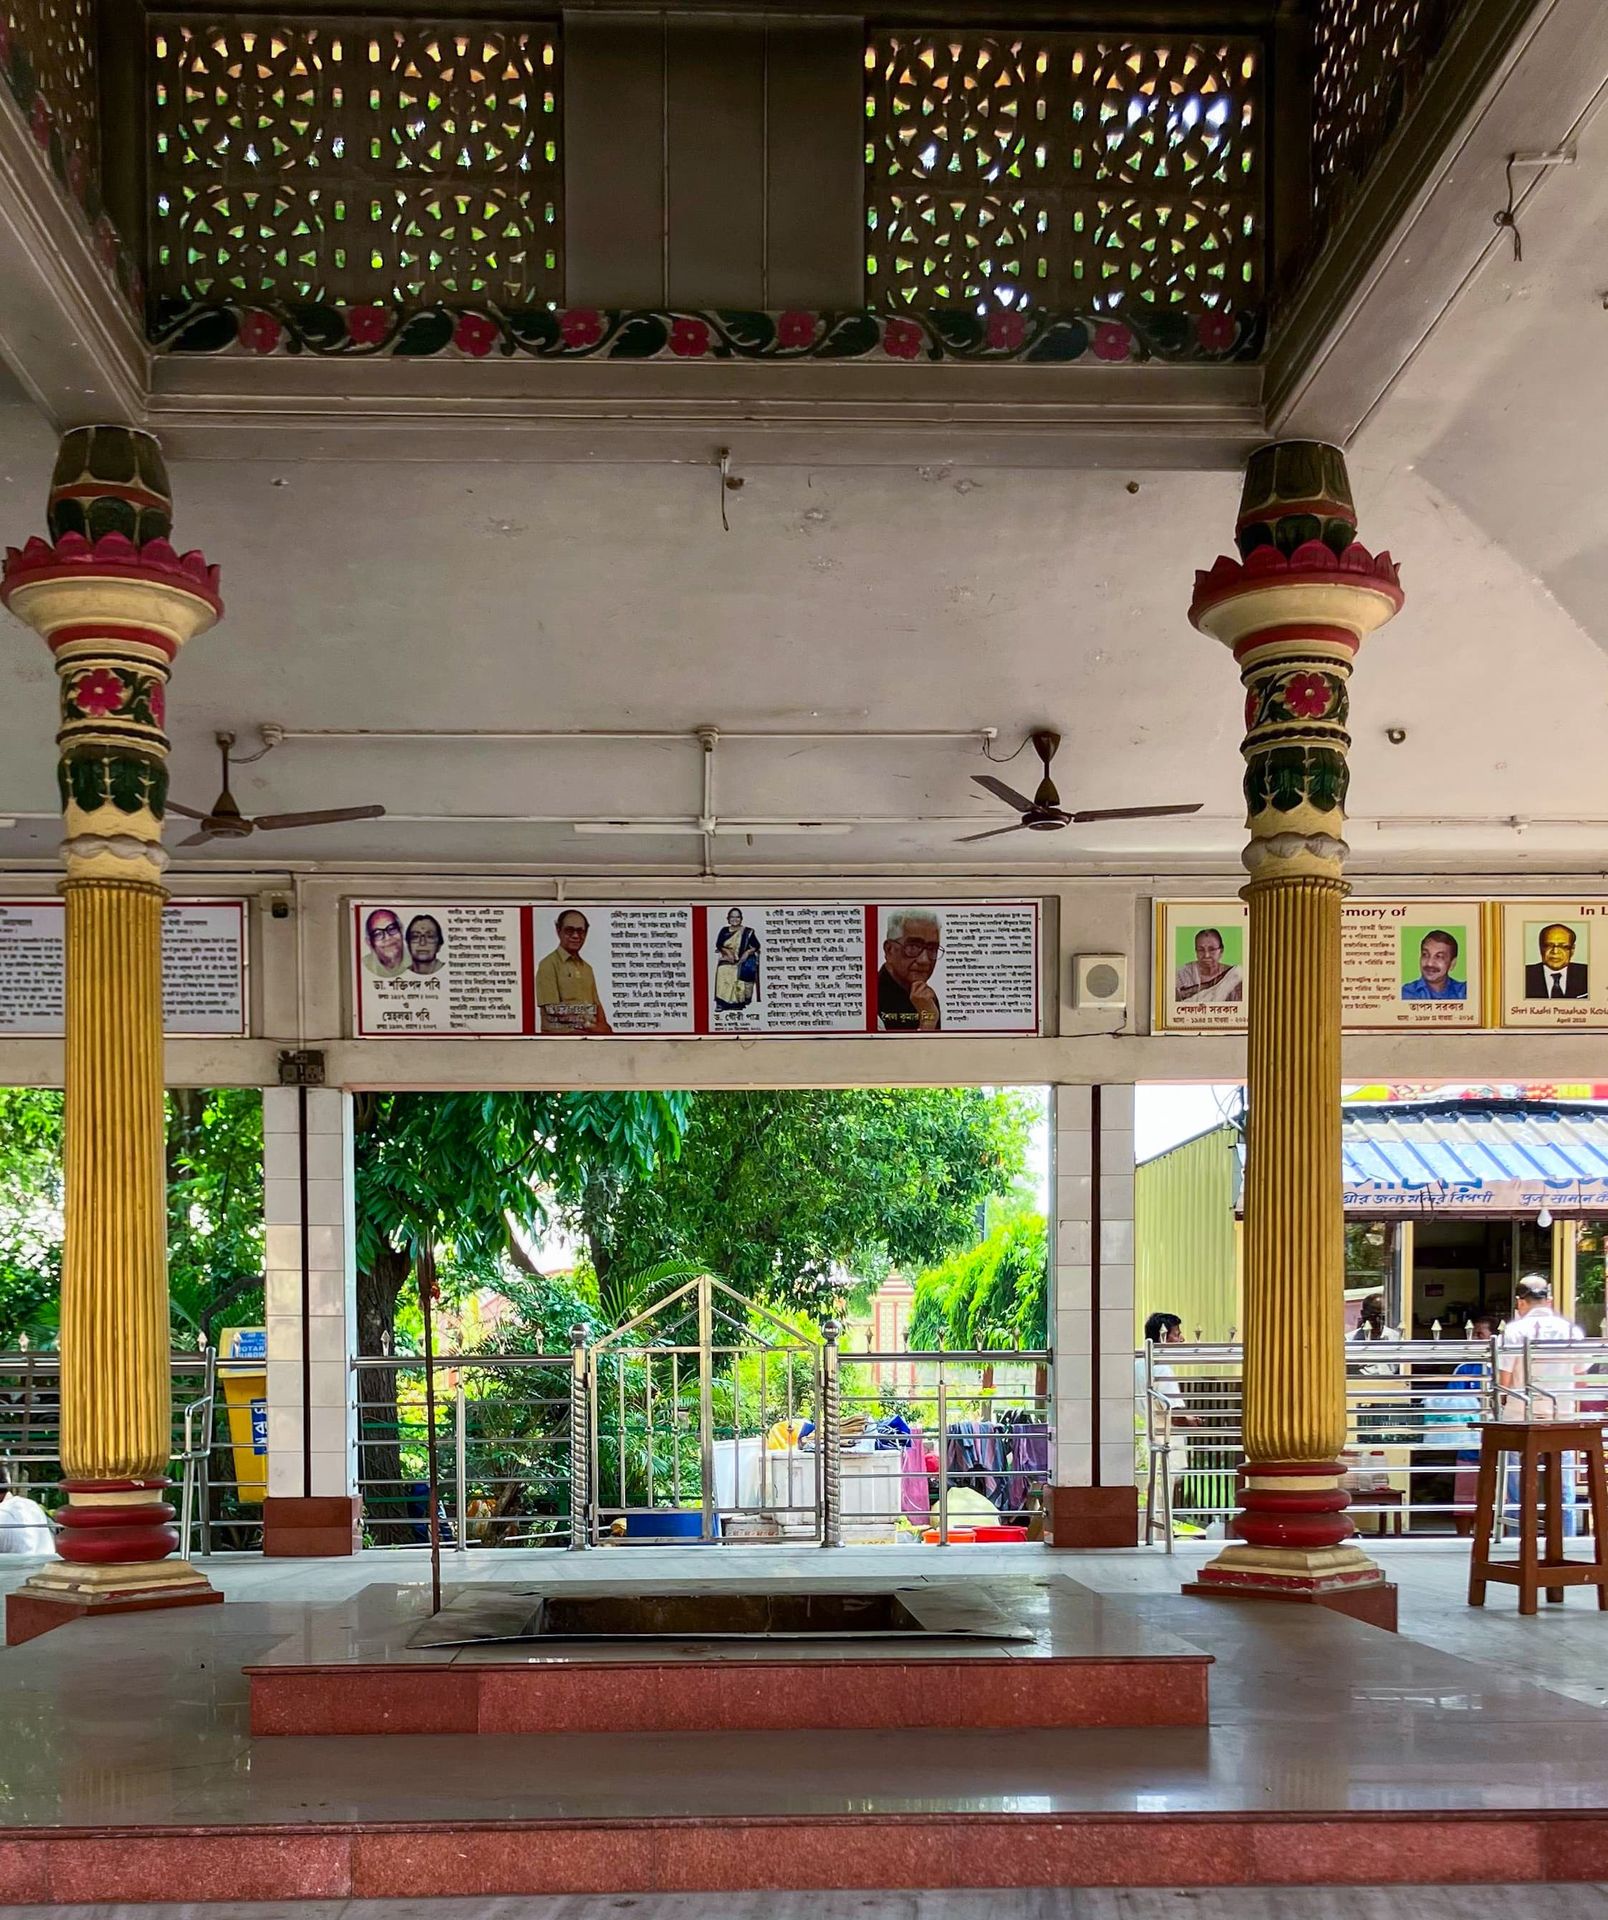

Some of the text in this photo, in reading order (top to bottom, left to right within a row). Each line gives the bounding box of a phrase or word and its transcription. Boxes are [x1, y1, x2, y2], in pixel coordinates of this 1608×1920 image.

[1341, 909, 1387, 920] mory
[1391, 906, 1407, 916] of
[1580, 906, 1595, 916] In
[1177, 1003, 1238, 1014] শেফালী সরকার
[1409, 1003, 1464, 1011] তাপস সরকার
[1511, 1006, 1528, 1015] Shri
[1344, 1191, 1373, 1204] গ্রীর
[1373, 1194, 1404, 1204] জন্য
[1450, 1191, 1494, 1204] বিপণী
